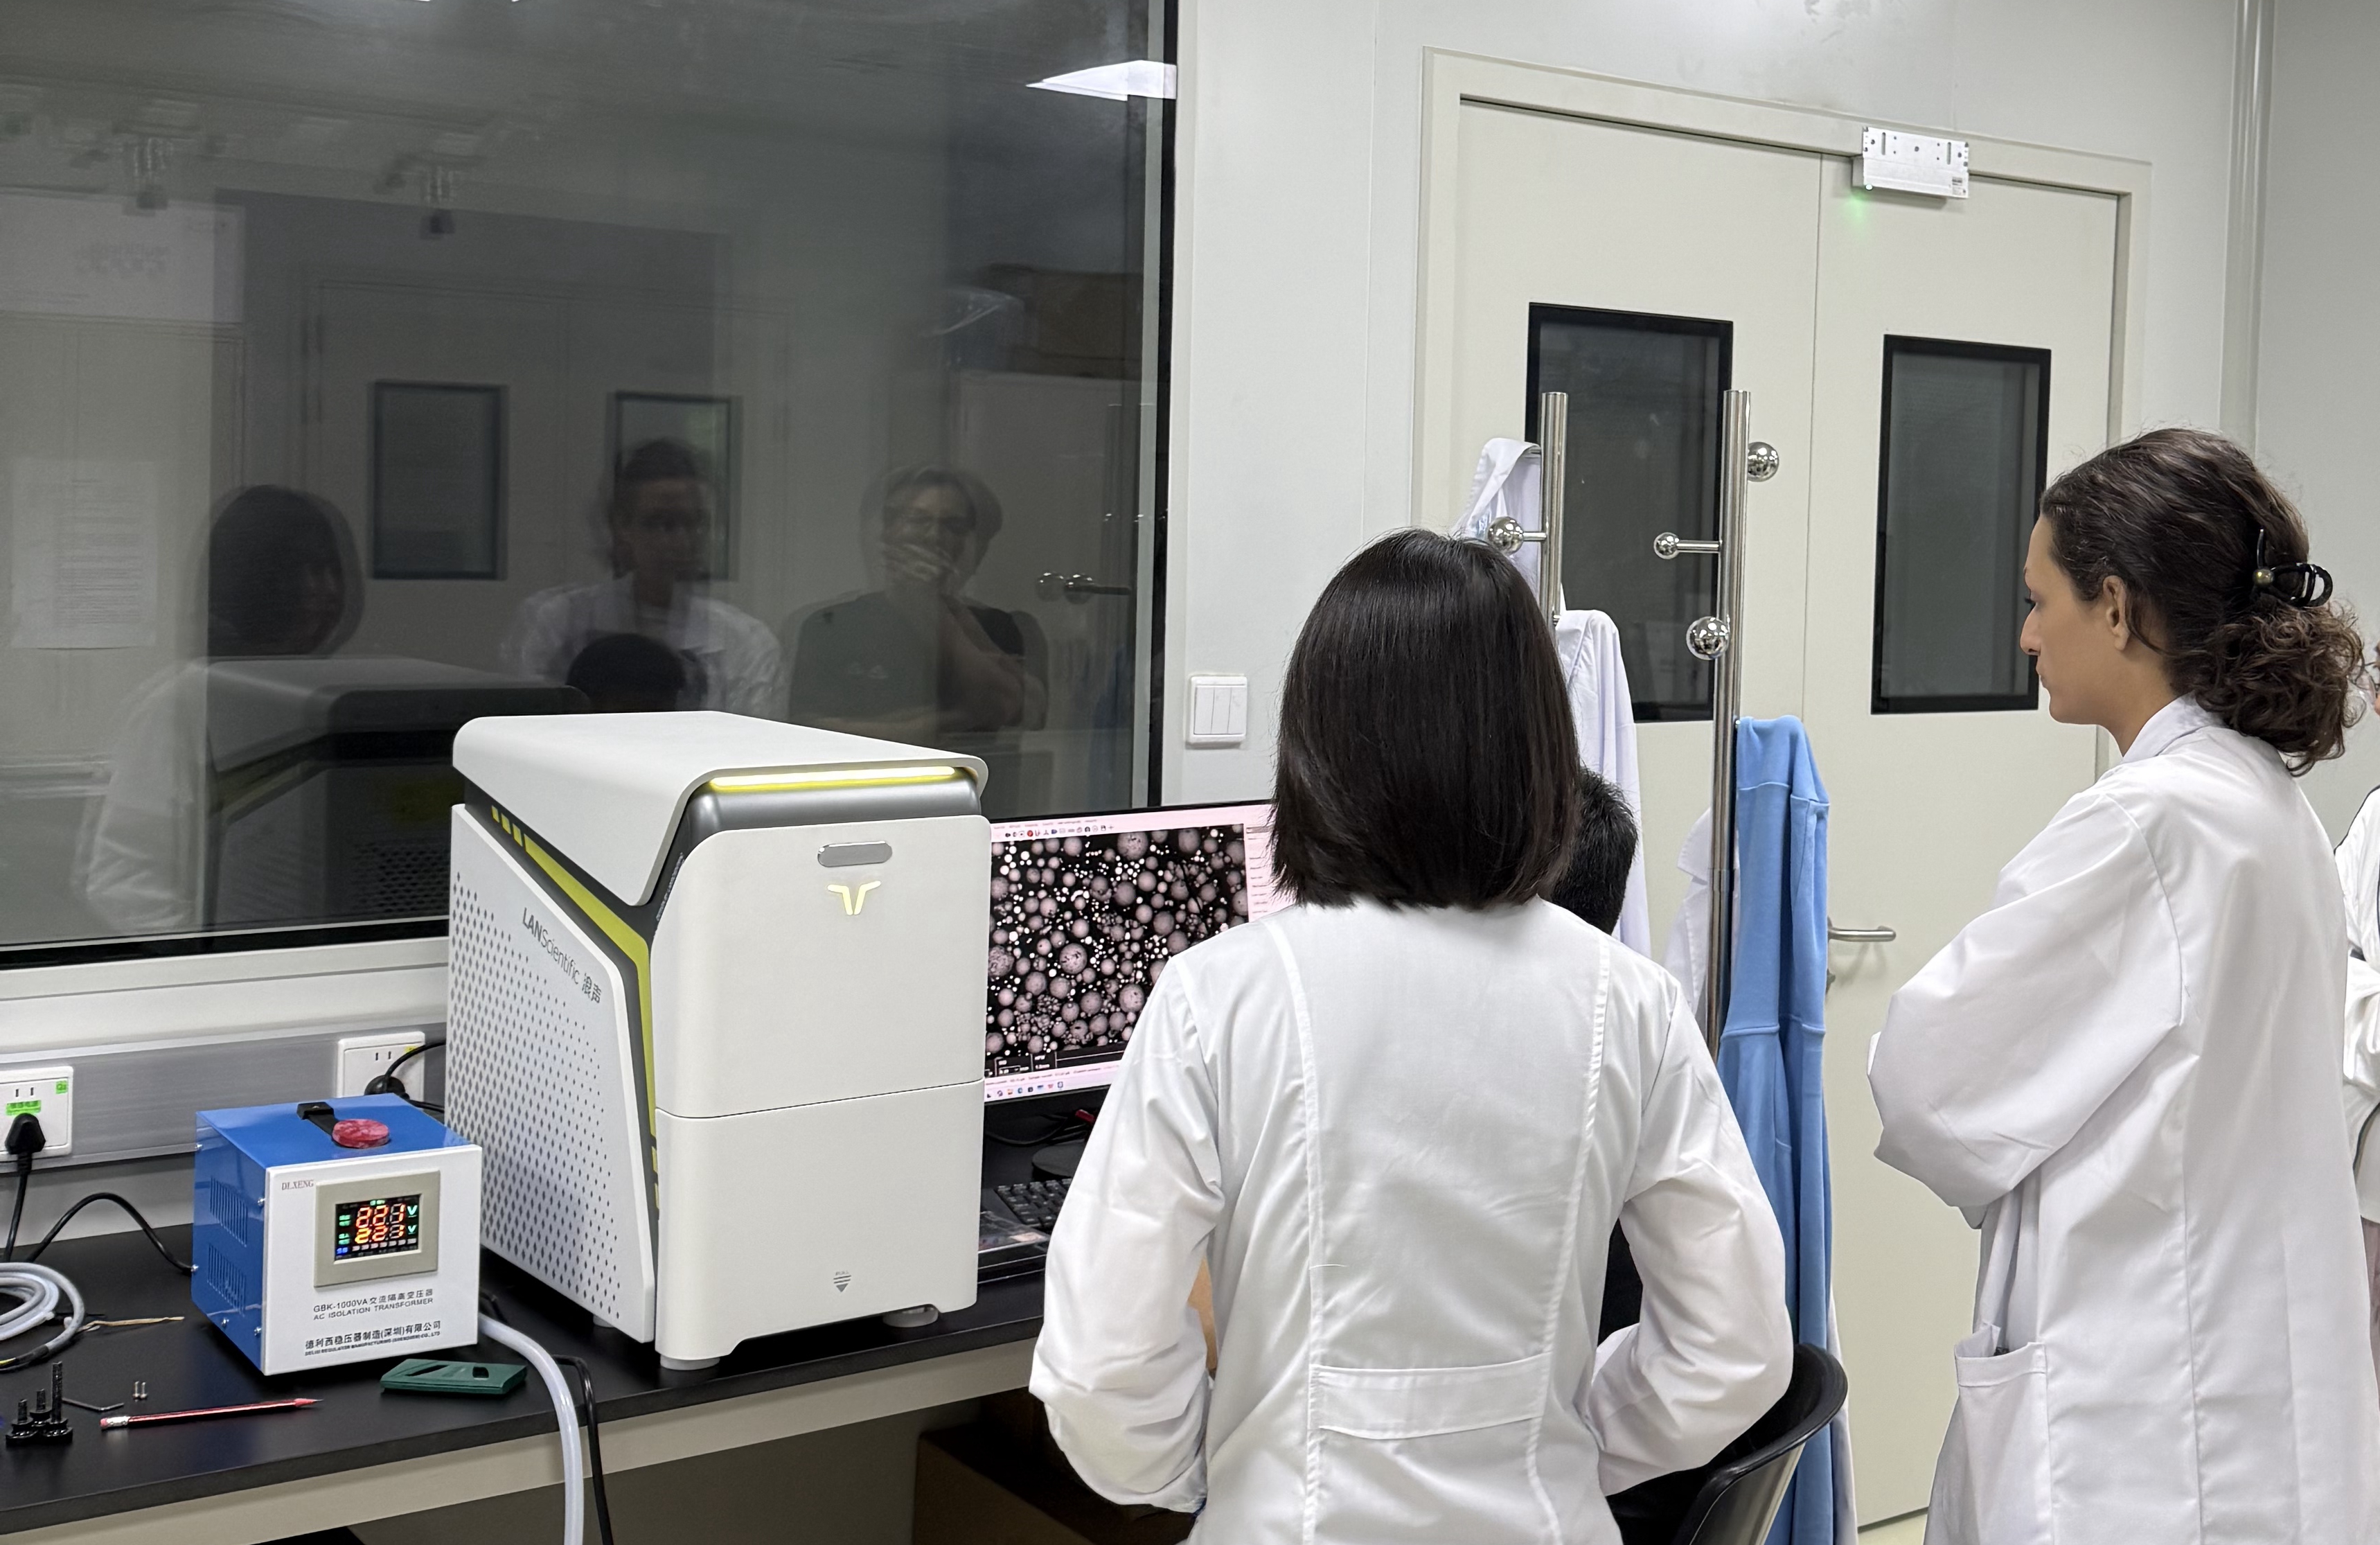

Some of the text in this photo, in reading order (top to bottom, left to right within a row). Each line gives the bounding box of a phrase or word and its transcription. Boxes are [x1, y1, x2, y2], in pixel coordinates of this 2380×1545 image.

[522, 907, 580, 985] LANScientific
[328, 1307, 371, 1318] ISOLATION
[374, 1298, 434, 1312] TRANSFORMER
